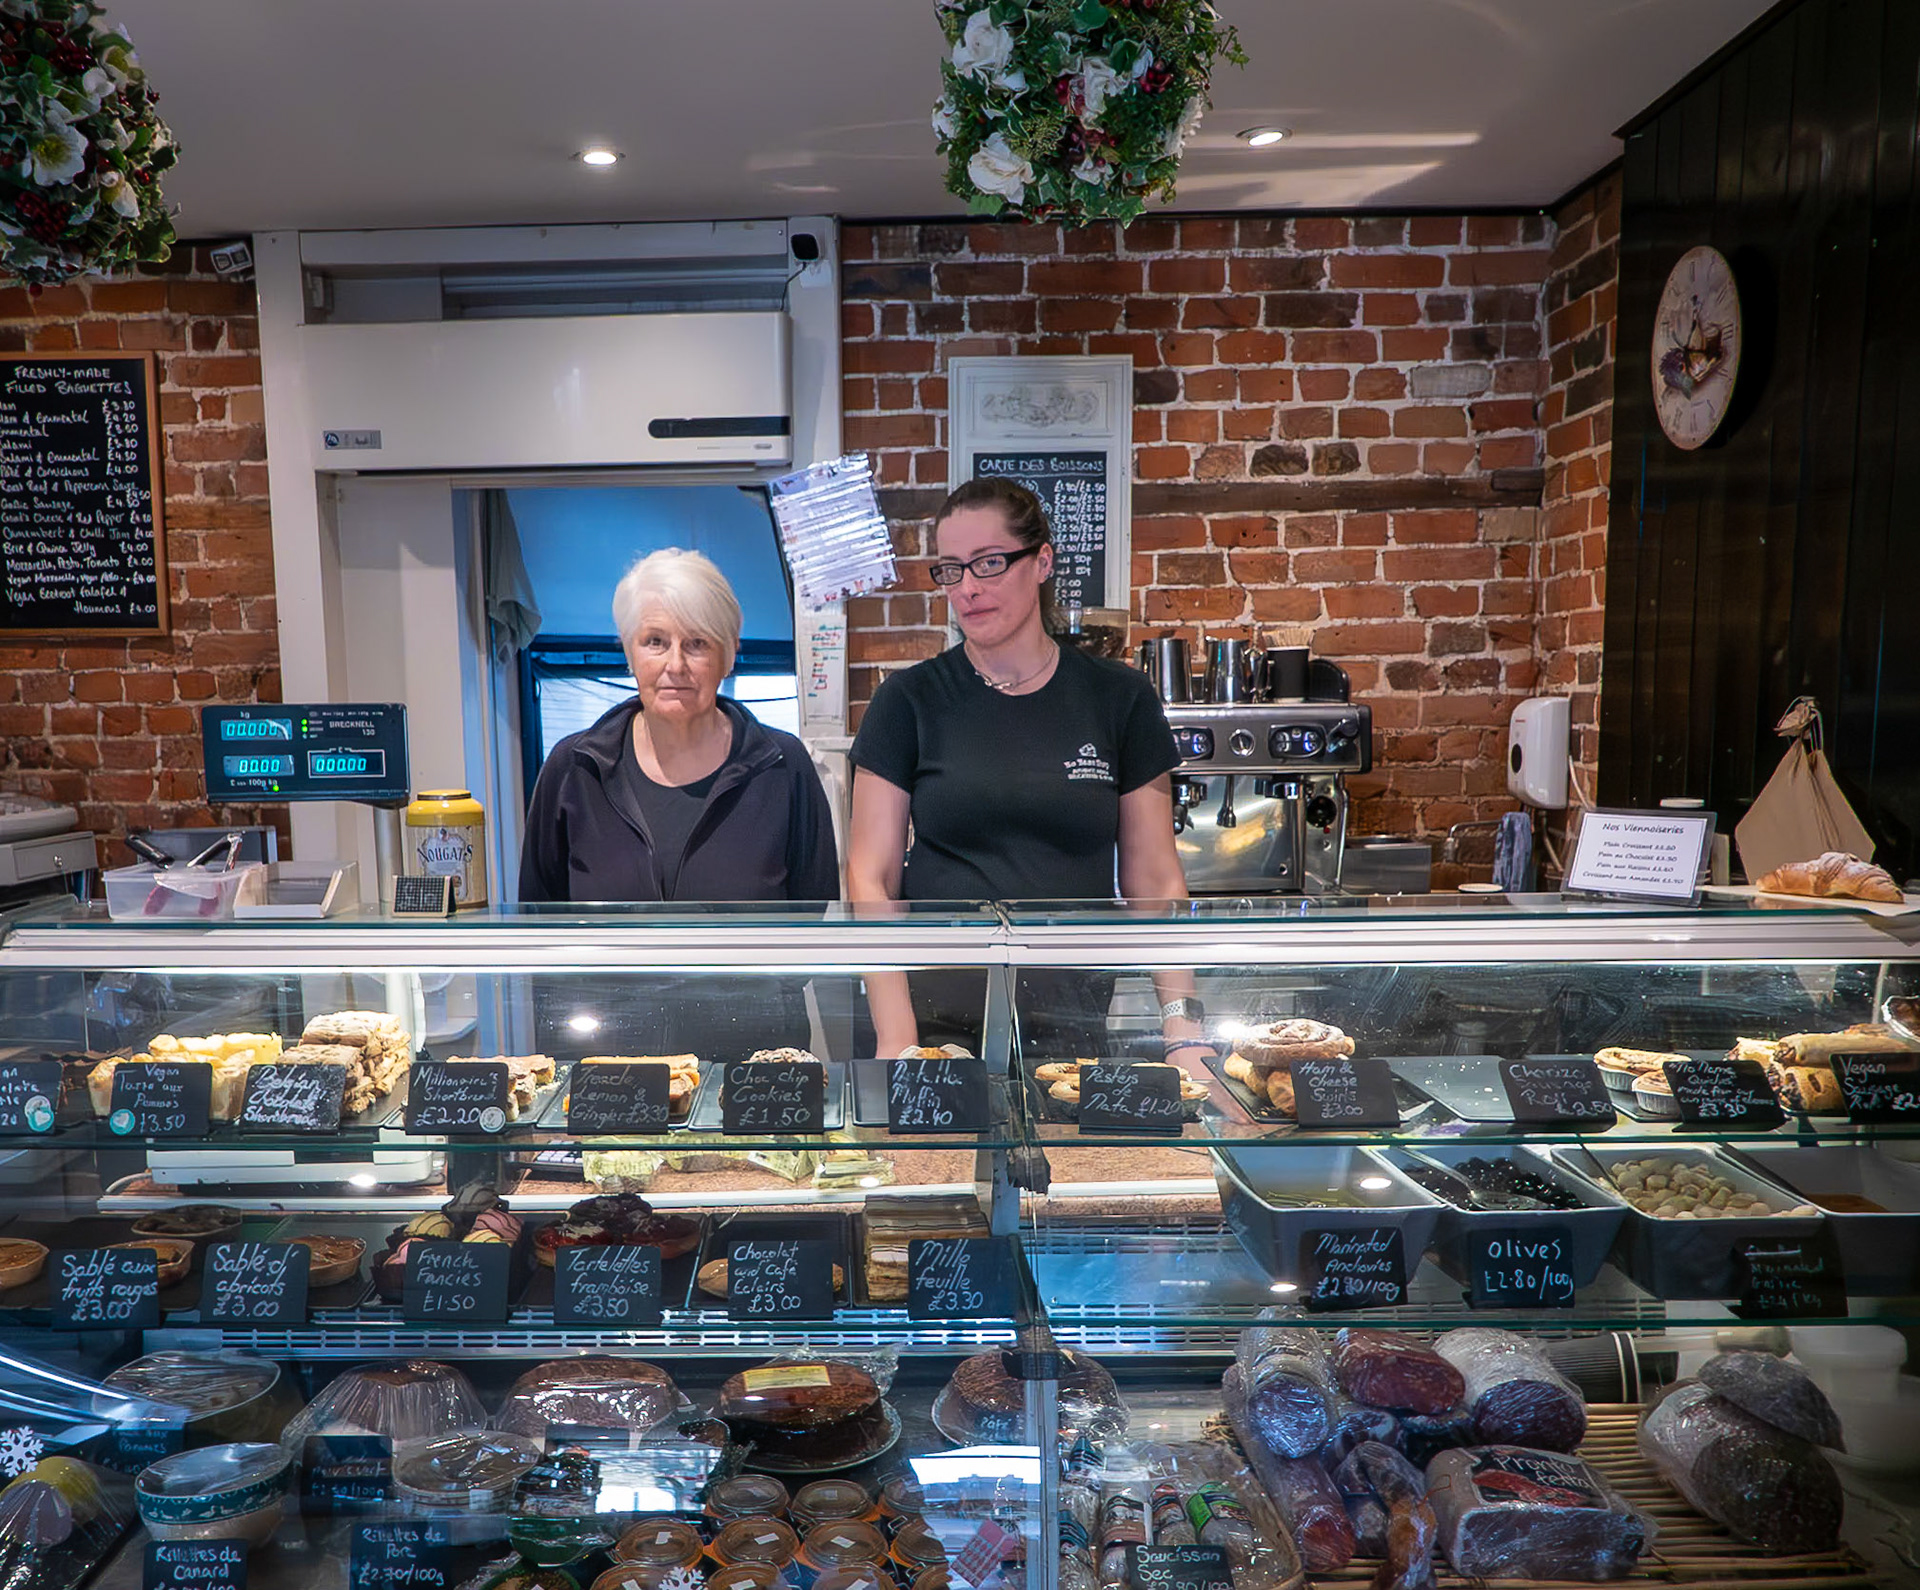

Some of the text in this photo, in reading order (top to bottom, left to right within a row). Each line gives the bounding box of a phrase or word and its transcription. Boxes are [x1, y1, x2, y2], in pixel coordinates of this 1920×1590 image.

[5, 380, 132, 395] FILLED BAGUETTES
[978, 457, 1104, 473] CARTE DES BOISSONS
[329, 720, 375, 730] BRECKNELL
[1602, 823, 1684, 835] Nos Viennoiseries
[730, 1066, 770, 1085] Choc
[1839, 1055, 1886, 1084] Vegan
[574, 1085, 646, 1103] Lemon &
[1112, 1082, 1132, 1098] de
[415, 1106, 481, 1126] £2.20
[739, 1105, 812, 1126] £1.50
[898, 1106, 954, 1126] £2.40
[1134, 1096, 1183, 1119] £1.20
[1321, 1102, 1364, 1119] £3.00
[61, 1248, 117, 1278] Sablé
[213, 1243, 267, 1273] Sablé
[417, 1247, 480, 1270] French
[915, 1239, 971, 1269] Mille
[216, 1266, 286, 1297] abricots
[417, 1266, 483, 1288] Fancies
[71, 1298, 133, 1322] £3.00
[213, 1292, 280, 1317] £3.00
[573, 1295, 629, 1318] £3.50
[749, 1294, 802, 1313] £3.00
[928, 1290, 984, 1312] £3.30
[424, 1526, 446, 1543] de
[219, 1545, 242, 1563] de
[173, 1562, 230, 1581] Canard
[1137, 1563, 1174, 1582] Sec
